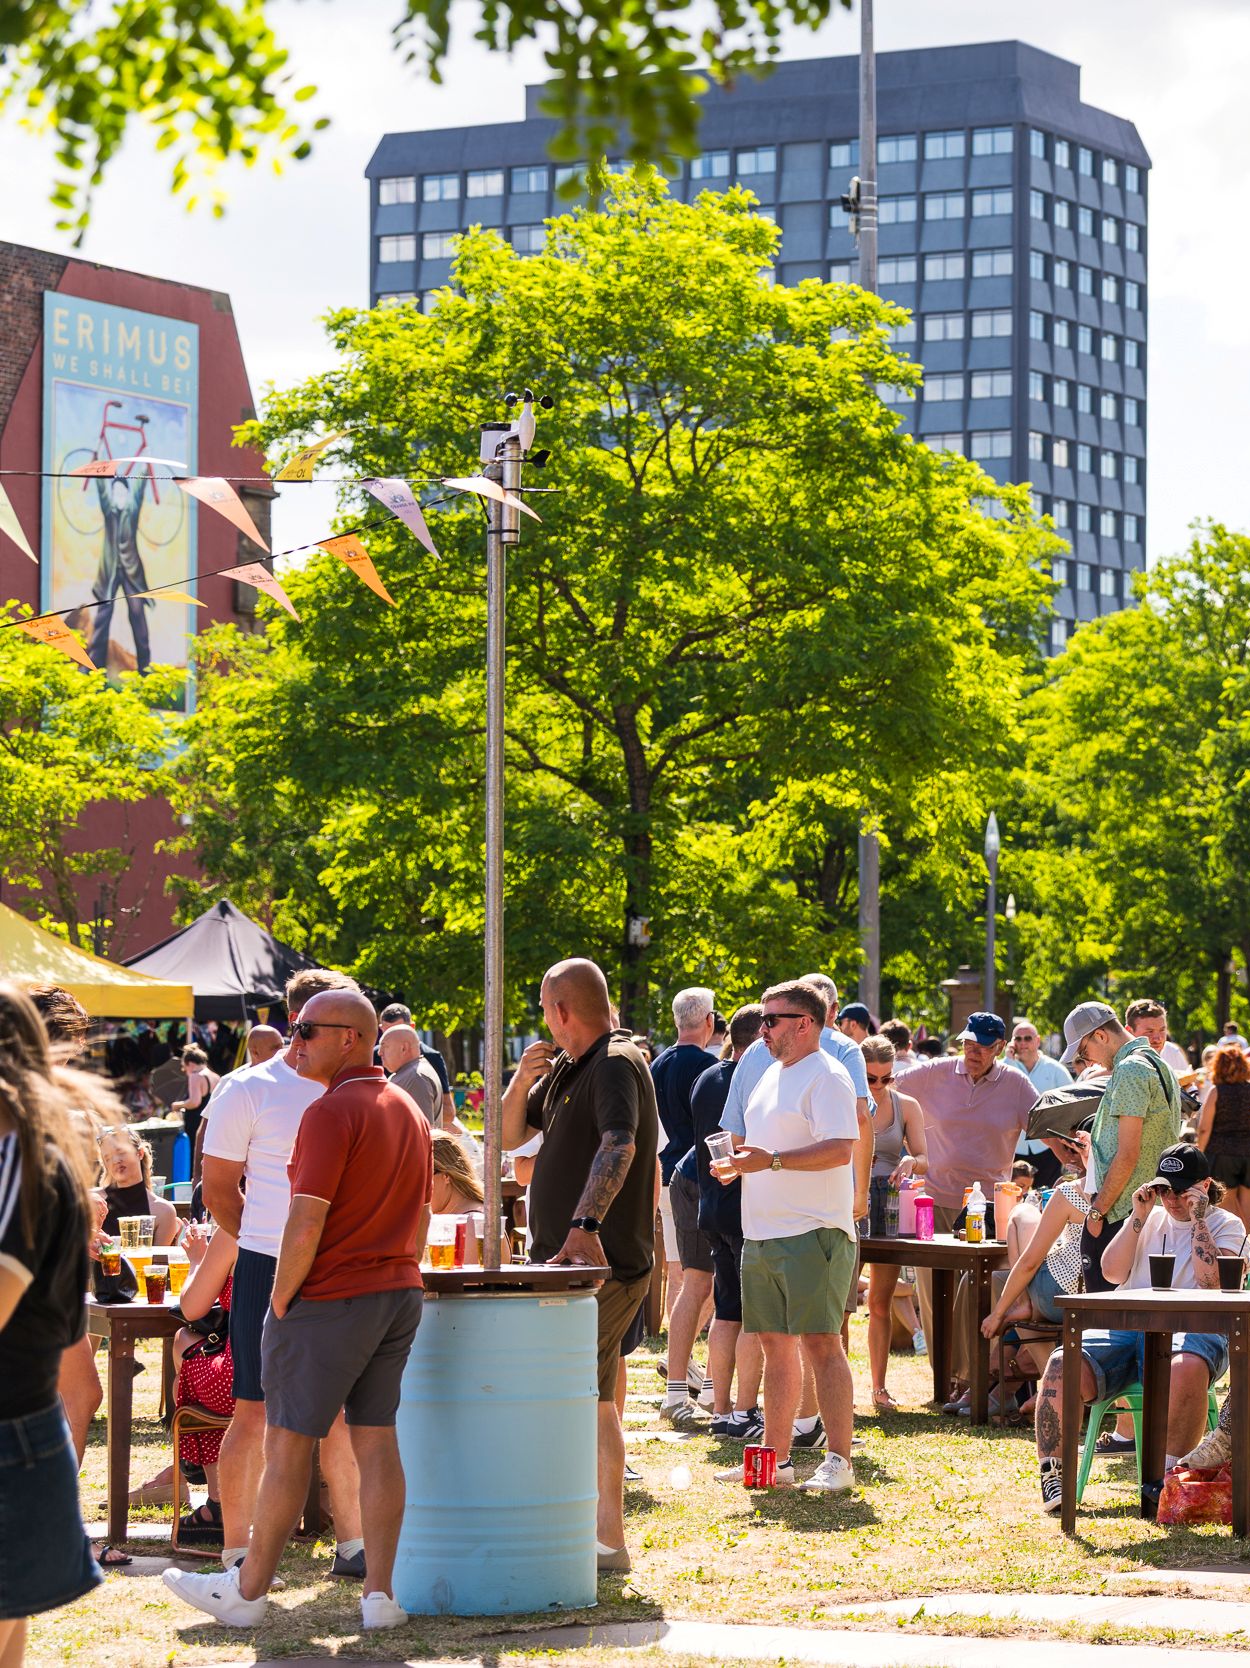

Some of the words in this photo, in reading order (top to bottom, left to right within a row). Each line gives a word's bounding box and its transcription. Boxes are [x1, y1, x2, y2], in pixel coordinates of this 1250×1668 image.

[53, 307, 191, 372] ERIMUS
[52, 352, 79, 373] WE
[89, 360, 152, 388] SHALL
[162, 374, 190, 395] BE!
